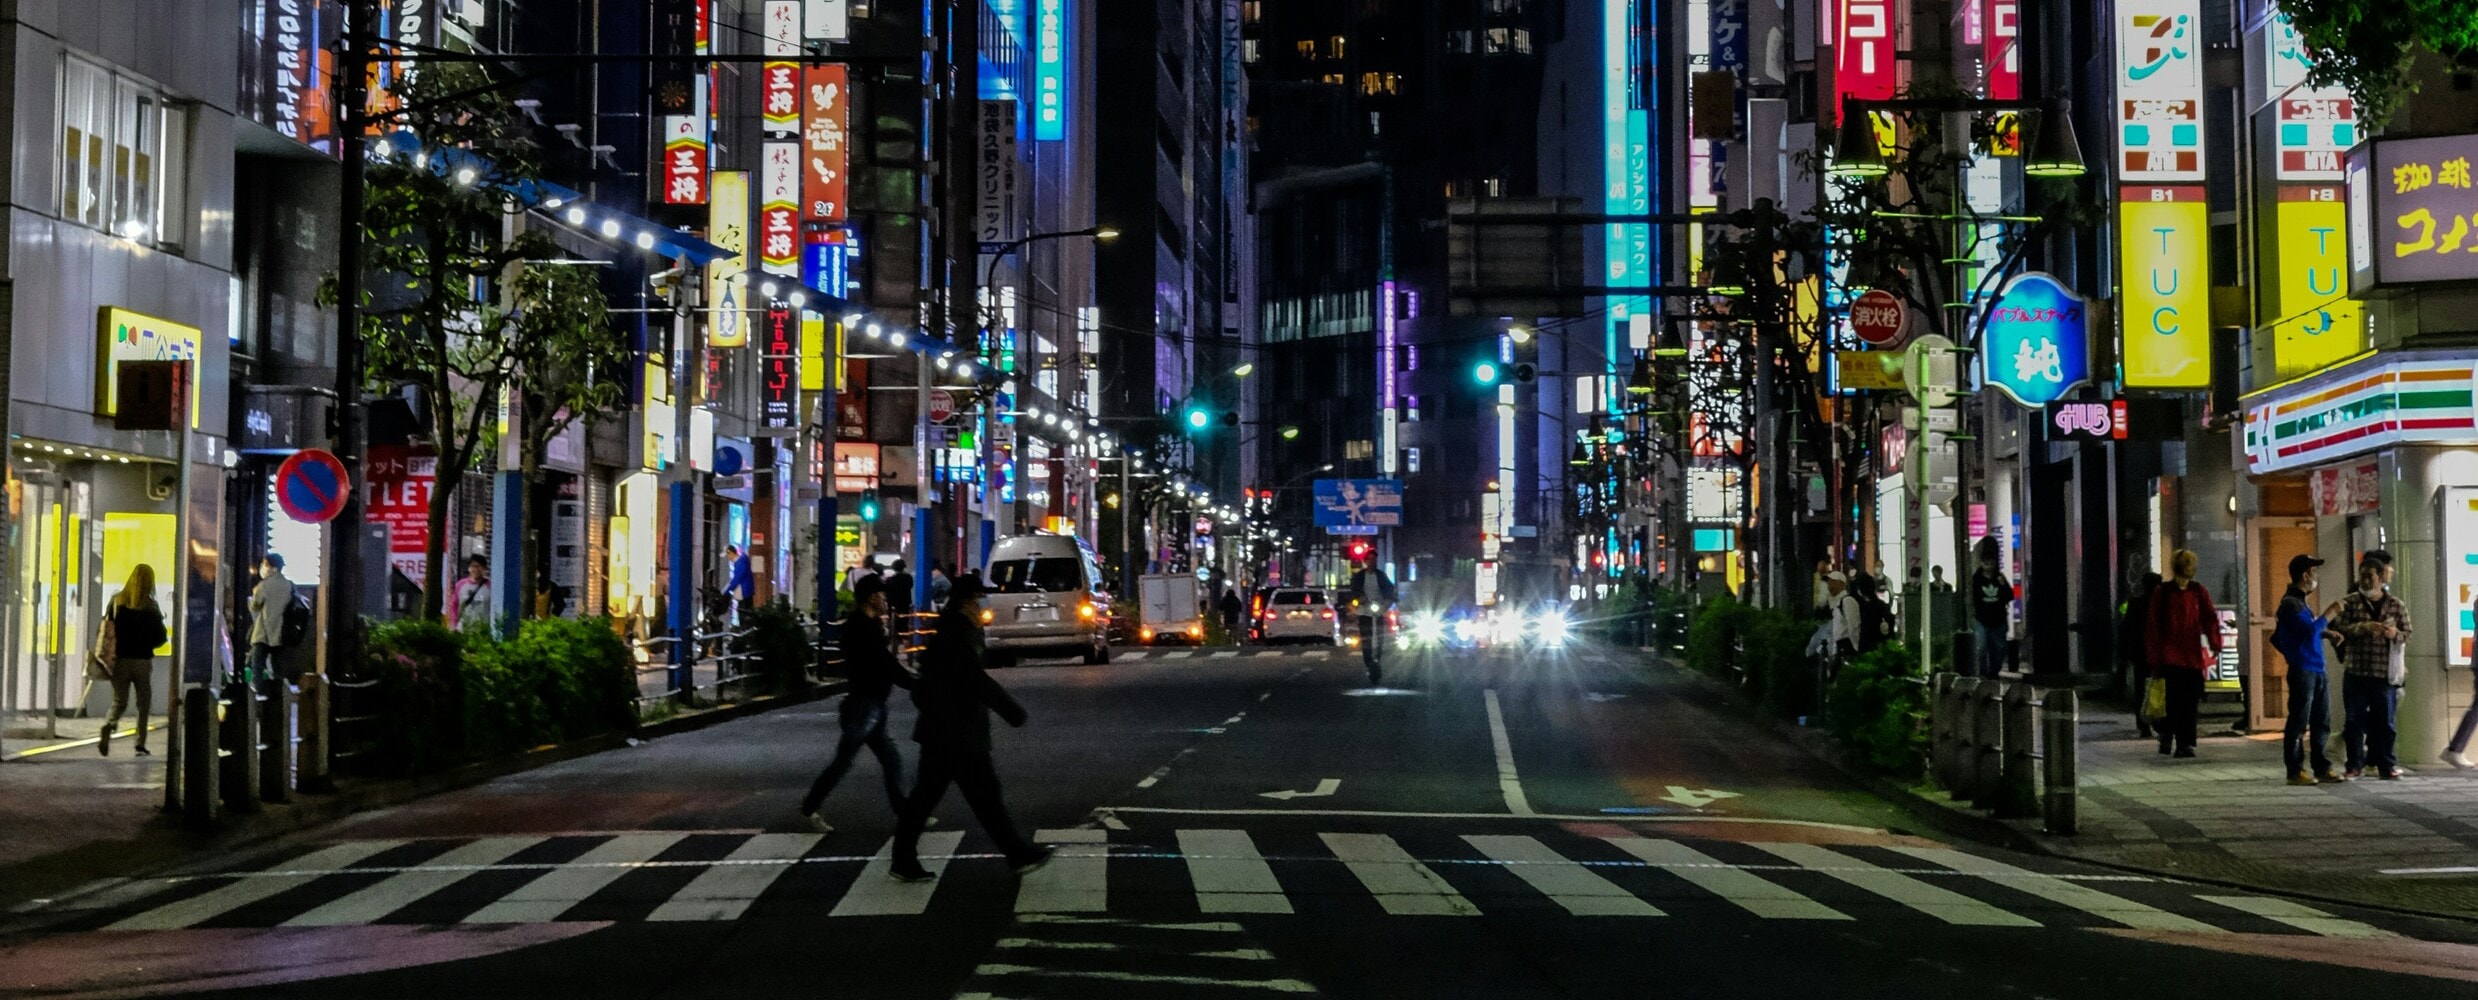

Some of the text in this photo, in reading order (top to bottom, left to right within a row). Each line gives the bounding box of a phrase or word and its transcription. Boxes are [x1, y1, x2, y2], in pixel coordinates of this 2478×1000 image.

[1632, 144, 1645, 265] アリシアクニック
[2151, 188, 2174, 202] B1
[1854, 306, 1898, 329] 消火栓
[2055, 403, 2111, 436] HUB
